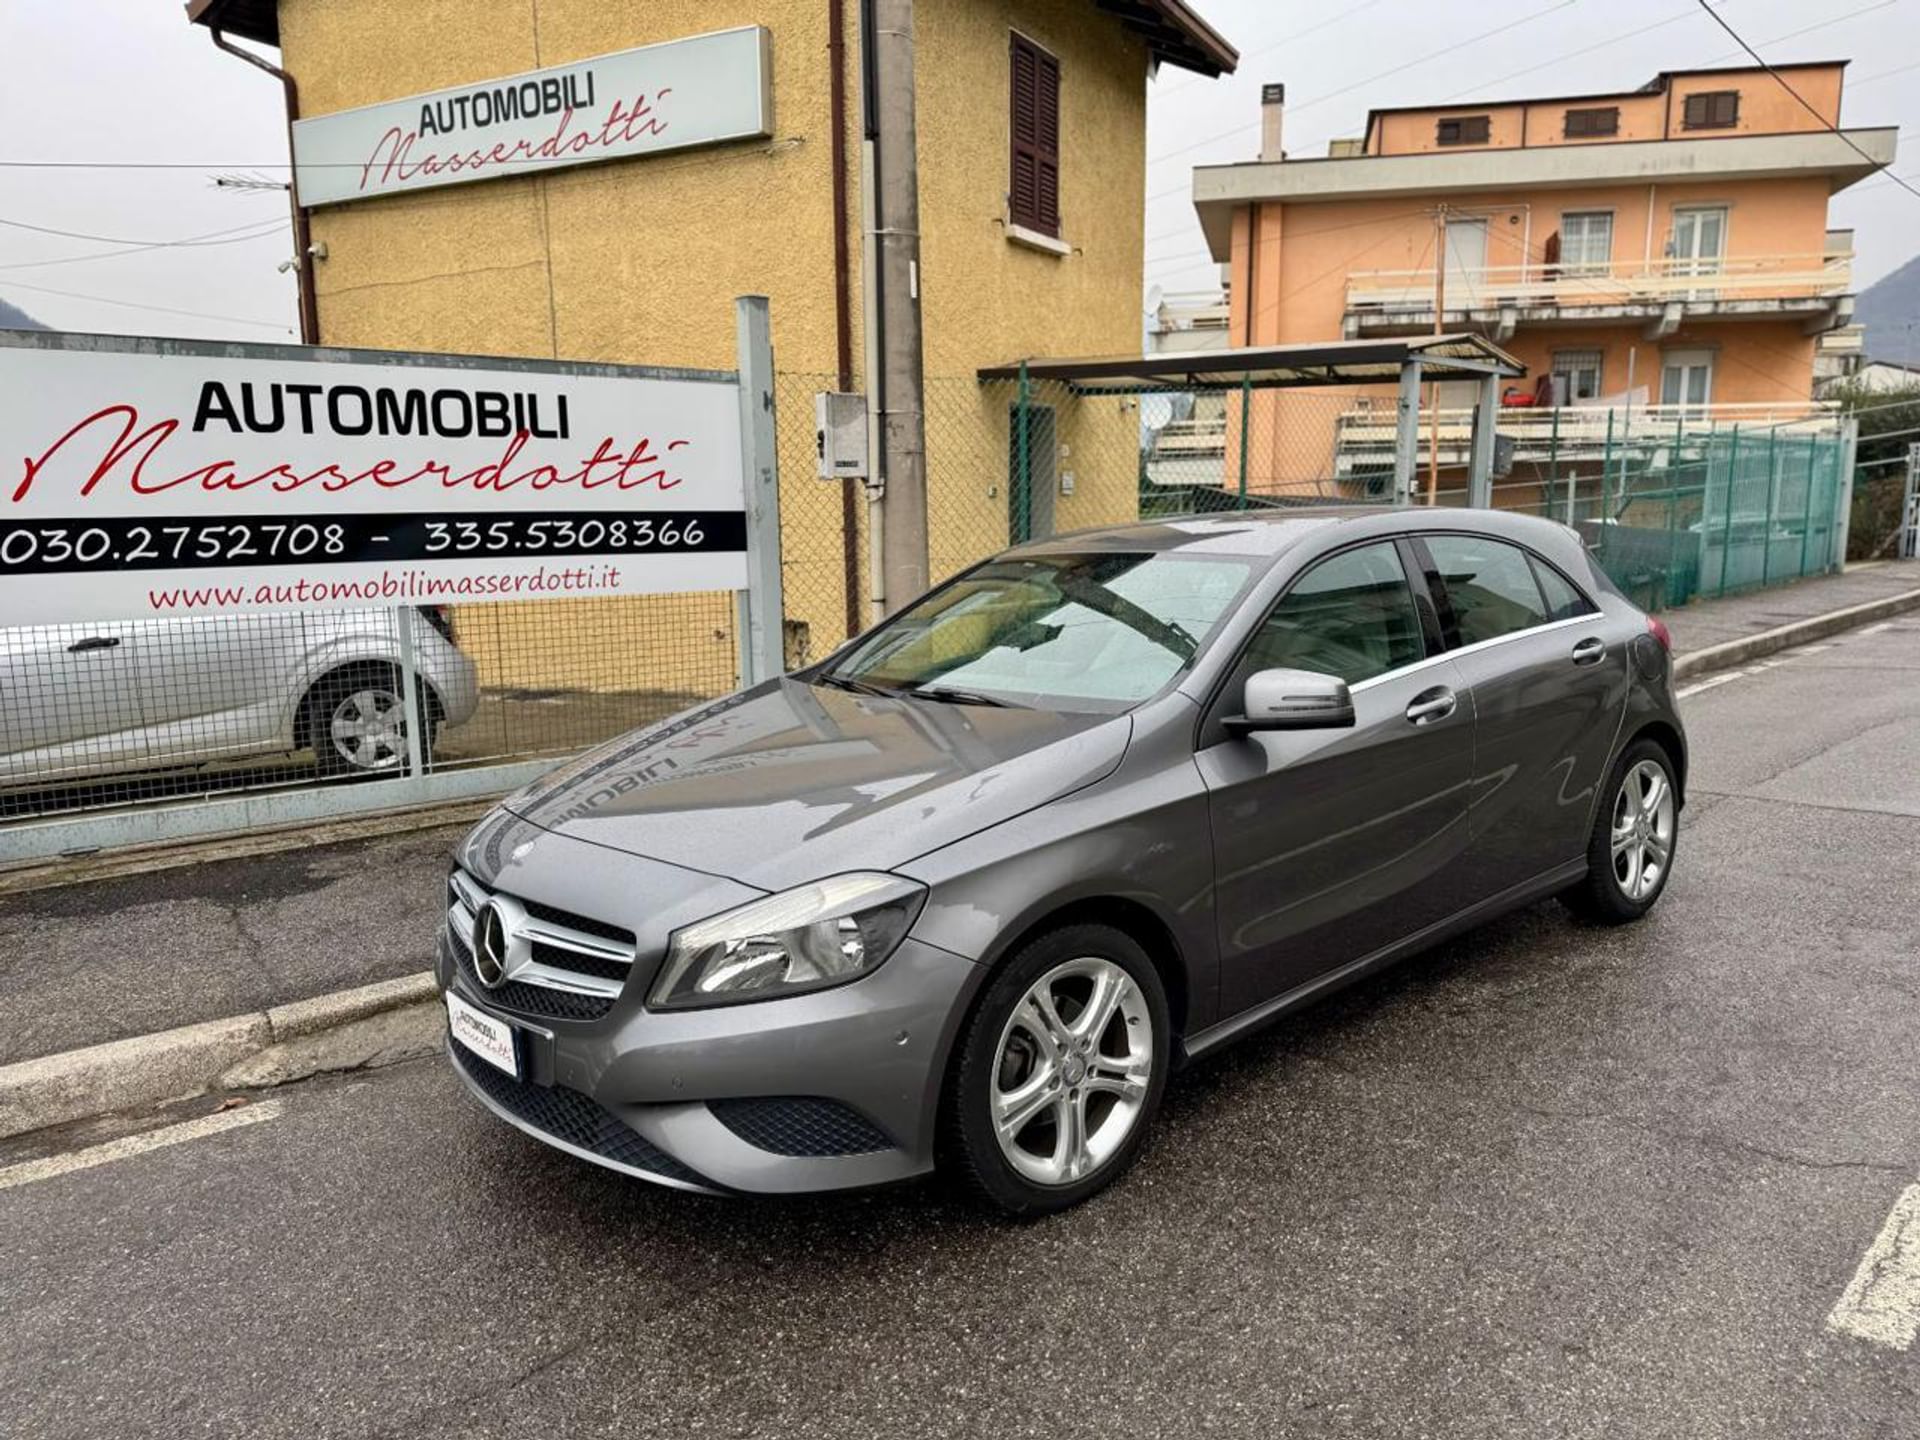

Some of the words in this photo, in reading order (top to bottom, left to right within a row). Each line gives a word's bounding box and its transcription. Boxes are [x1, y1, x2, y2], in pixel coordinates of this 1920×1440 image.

[419, 71, 595, 138] AUTOMOBILI
[359, 88, 673, 190] Masserdotti
[193, 380, 570, 440] AUTOMOBILI
[12, 404, 690, 503] Masserdotti
[0, 522, 347, 566] 030.2752708
[424, 519, 706, 552] 335.5308366
[149, 565, 621, 611] www.automobilimasserdotti.it
